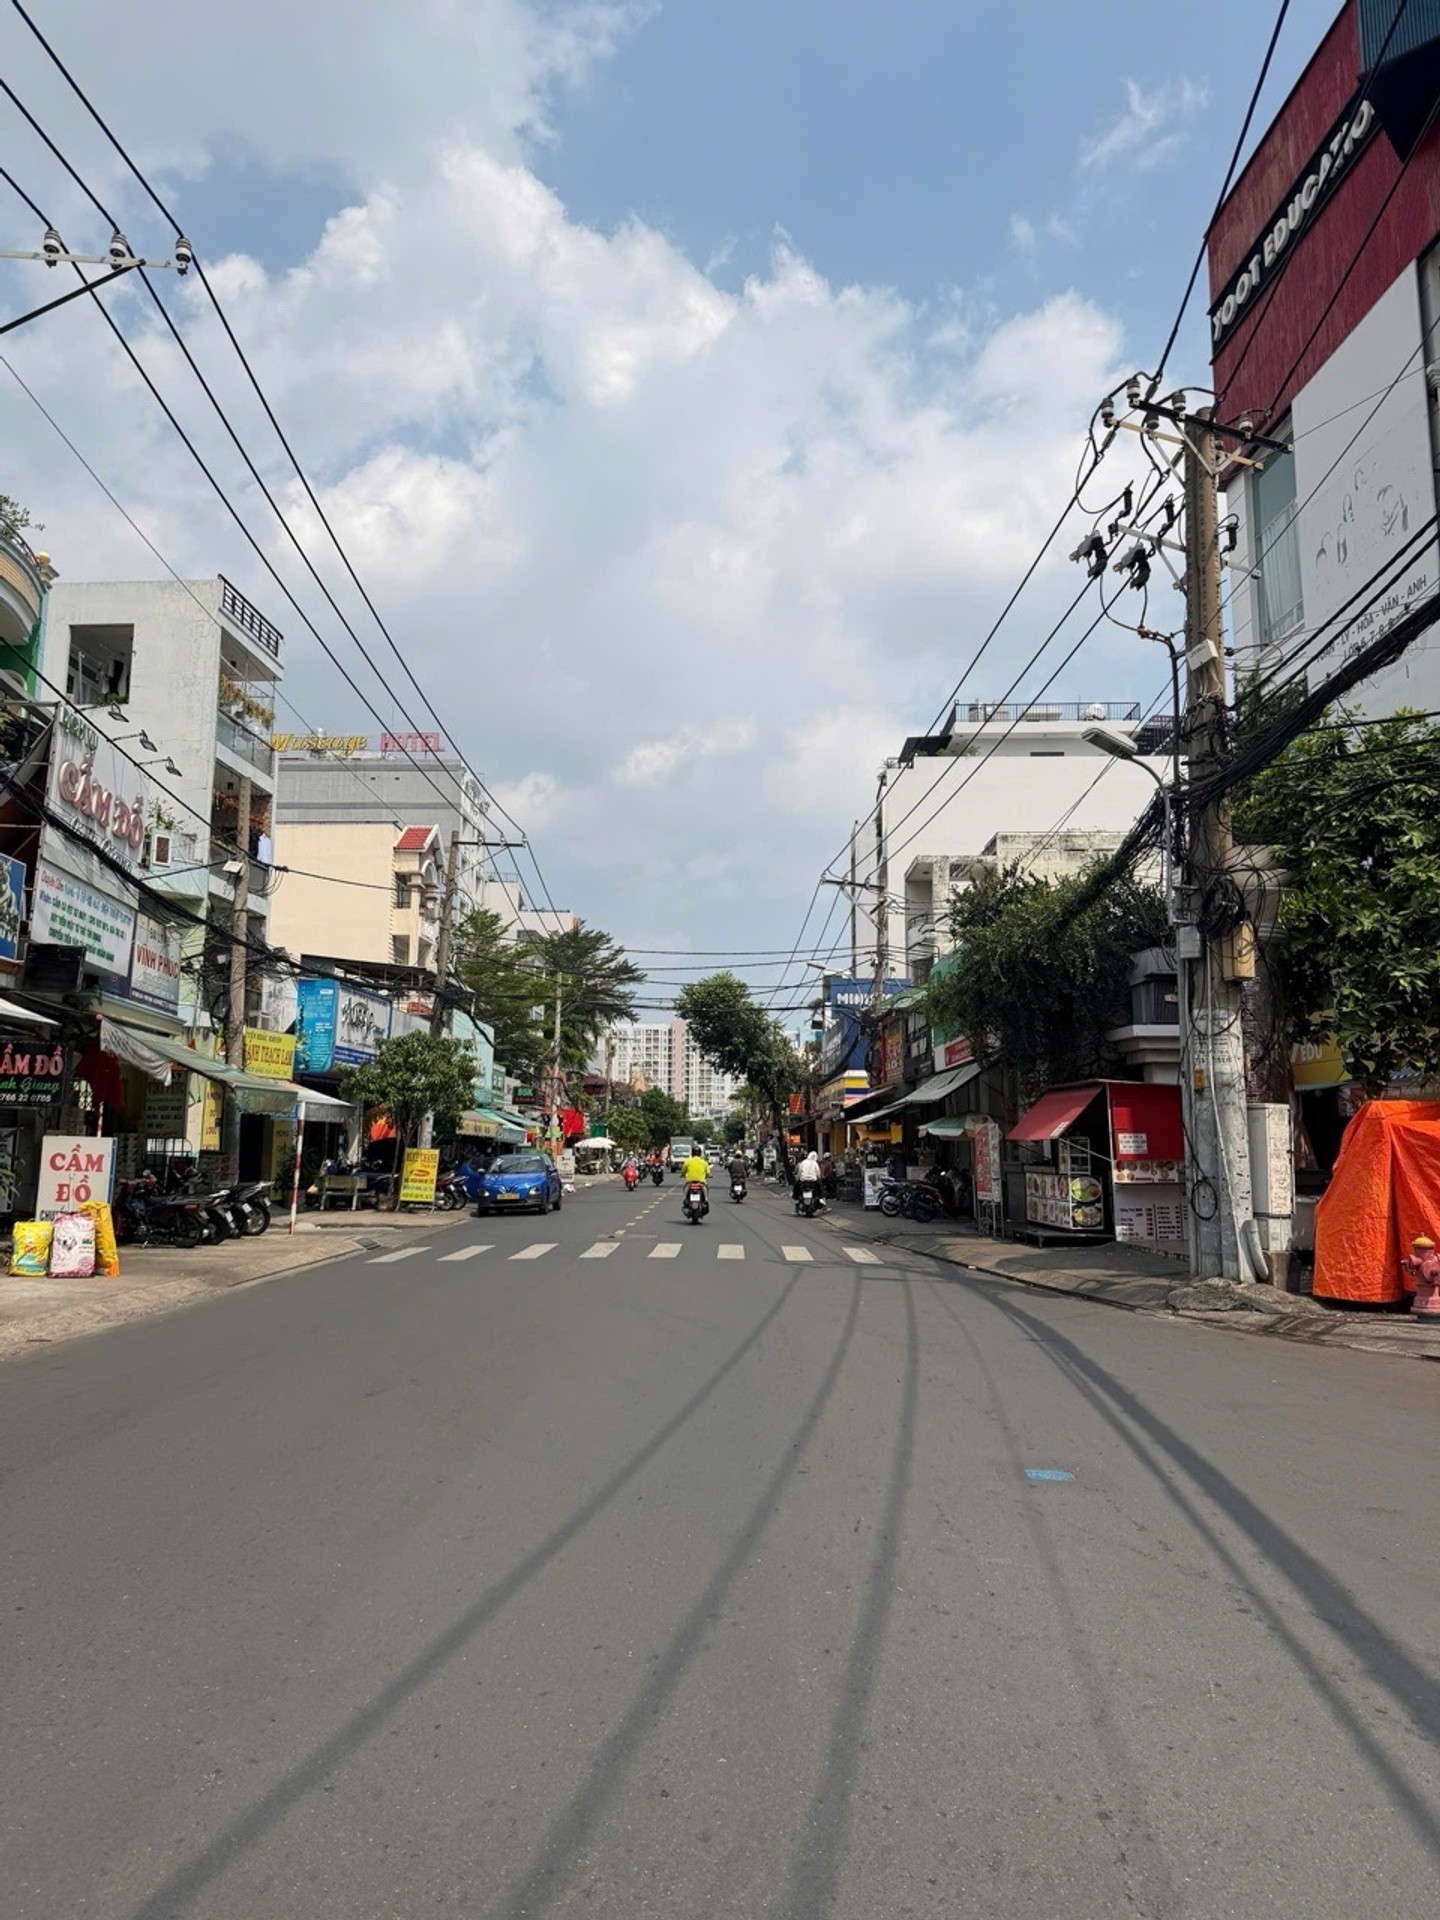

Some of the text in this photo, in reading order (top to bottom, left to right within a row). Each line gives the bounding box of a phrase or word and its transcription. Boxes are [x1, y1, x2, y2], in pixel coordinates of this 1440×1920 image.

[1263, 100, 1376, 268] EDUCATIO
[1407, 574, 1427, 599] ANH
[379, 731, 441, 752] HOTEL
[58, 752, 113, 829] CẦM
[112, 793, 144, 849] ĐỒ
[33, 1044, 64, 1077] ĐỒ
[49, 1143, 105, 1173] CẦM
[55, 1174, 92, 1203] ĐỒ
